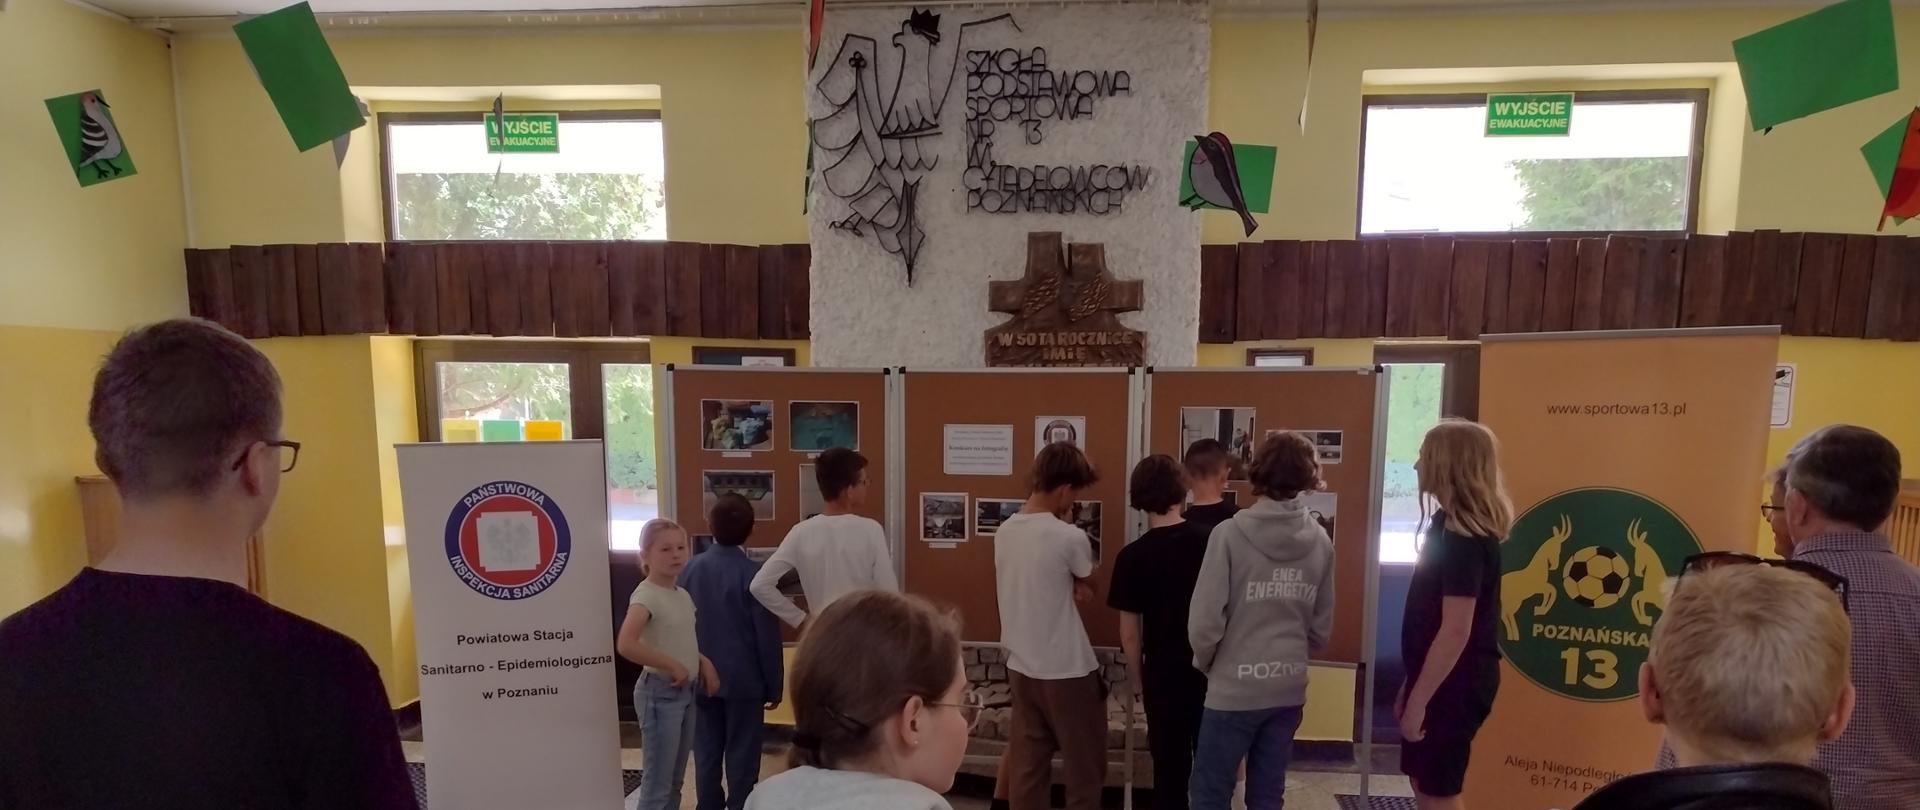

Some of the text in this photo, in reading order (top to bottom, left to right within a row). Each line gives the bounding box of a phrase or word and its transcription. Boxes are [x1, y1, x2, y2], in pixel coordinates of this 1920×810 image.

[966, 46, 1046, 74] SZKOŁA
[967, 70, 1131, 97] PODSTAWOWA
[966, 95, 1093, 121] SPORTOWA
[1495, 99, 1565, 115] WYJŚCIE
[966, 119, 1042, 145] NR 13
[1490, 119, 1567, 128] EWAKUACYJNE
[998, 333, 1013, 346] W
[1547, 402, 1686, 416] www.sportowa13.pl
[463, 483, 545, 507] PAŃSTWOWA
[450, 552, 567, 599] INSPEKCJA SANITARNA
[1272, 568, 1303, 582] ENEA
[457, 629, 574, 645] Powiatowa Stacja
[1532, 625, 1649, 648] POZNAŃSKA
[421, 663, 485, 675] Sanitarno
[498, 653, 612, 672] Epidemiologiczna
[1561, 647, 1619, 690] 13
[482, 685, 559, 699] w Poznaniu
[1504, 755, 1538, 771] Aleja
[1531, 774, 1577, 792] 61-714
